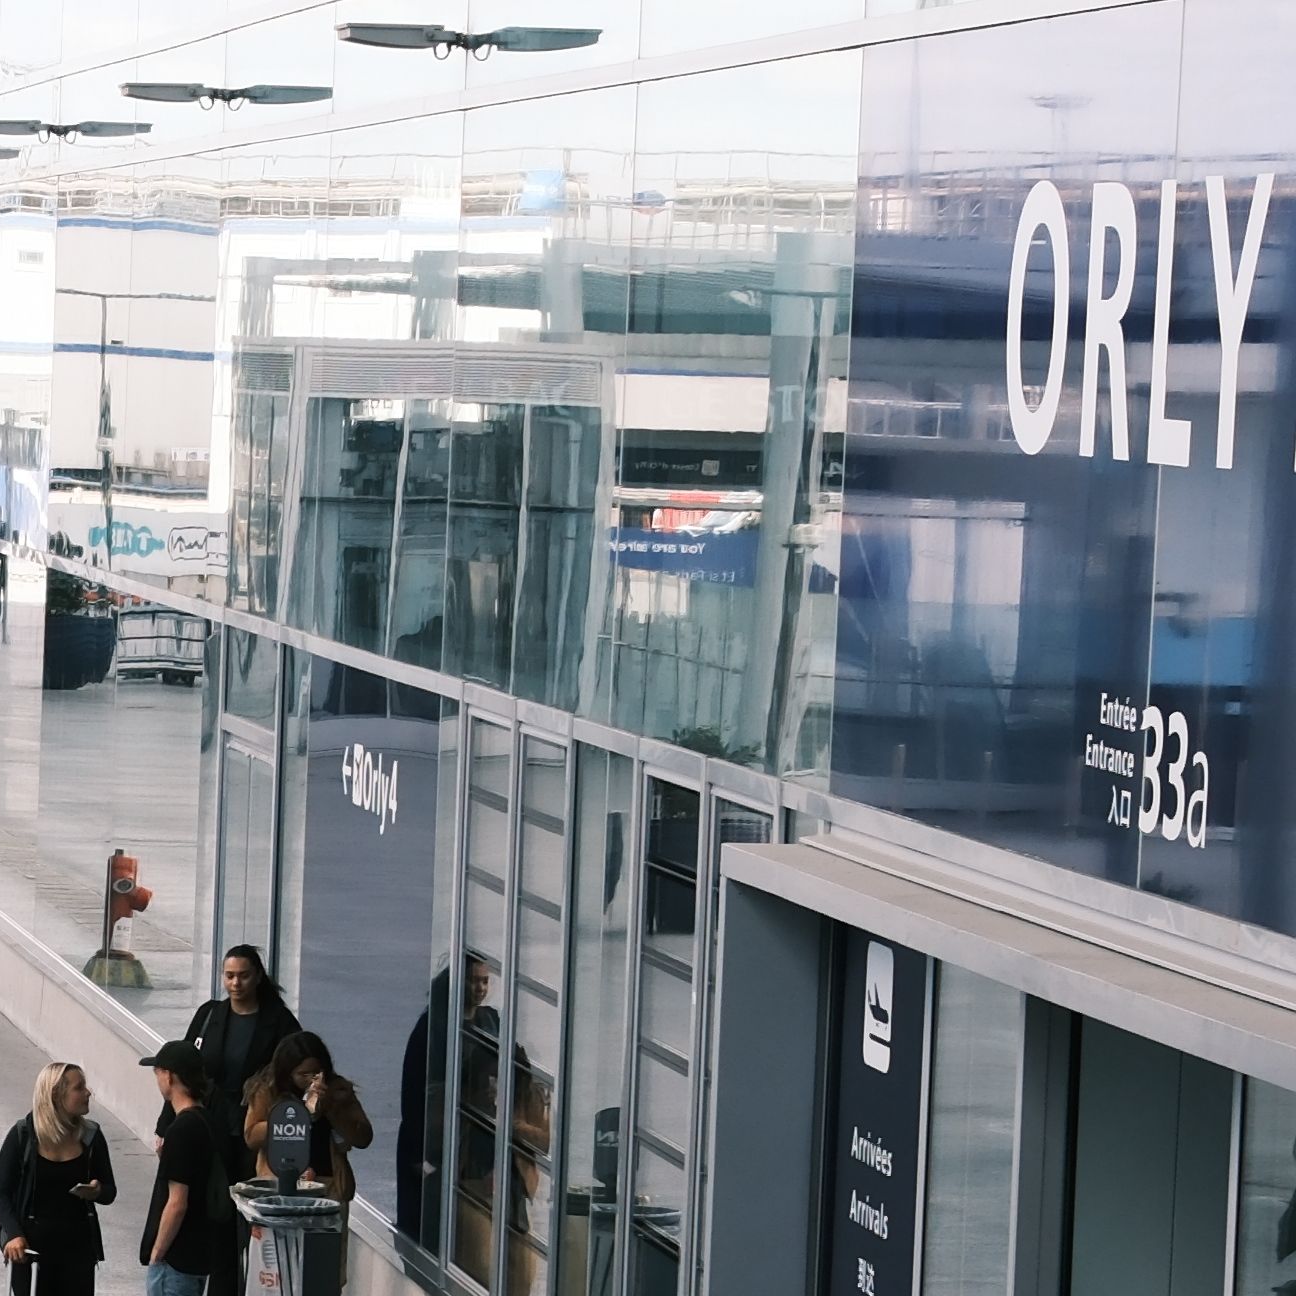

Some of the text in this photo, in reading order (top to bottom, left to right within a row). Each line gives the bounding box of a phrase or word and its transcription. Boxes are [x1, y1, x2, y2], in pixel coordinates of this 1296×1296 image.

[1006, 173, 1275, 470] ORLY
[1100, 692, 1137, 732] Entrée
[1085, 733, 1135, 778] Entrance
[1108, 785, 1132, 828] 入口
[273, 1123, 306, 1136] NON
[851, 1126, 892, 1177] Arrivées
[849, 1189, 889, 1240] Arrivals
